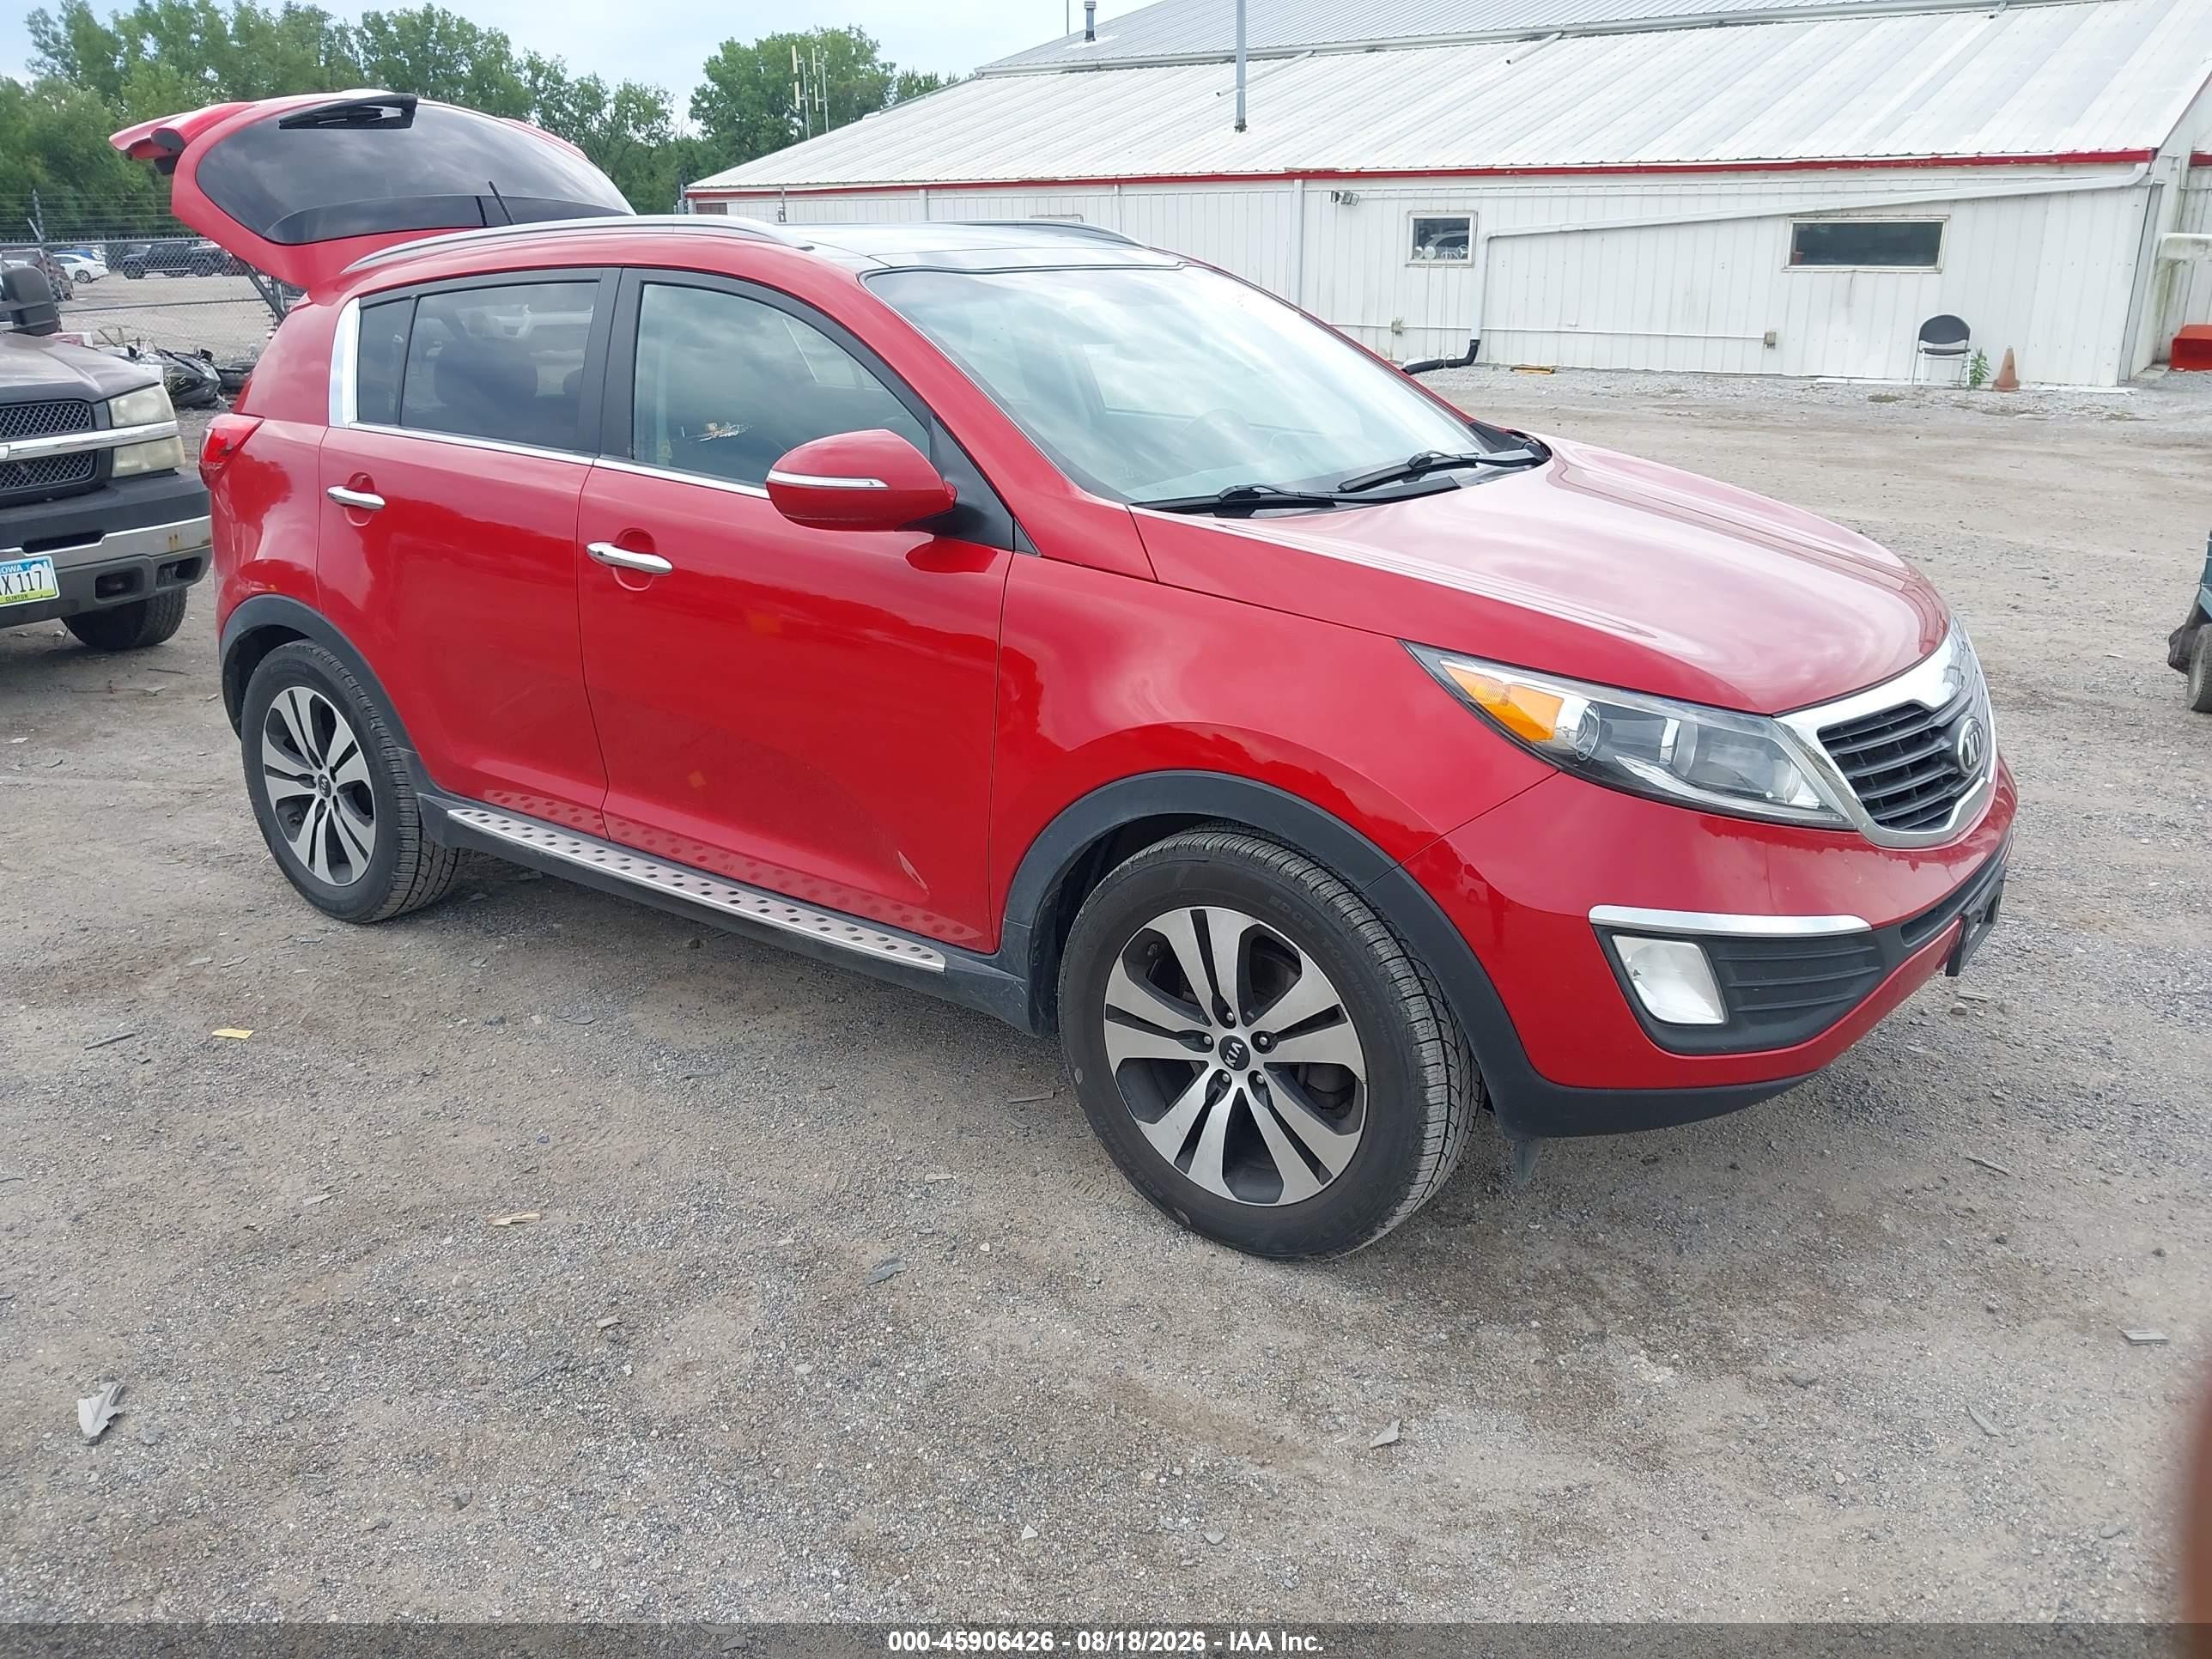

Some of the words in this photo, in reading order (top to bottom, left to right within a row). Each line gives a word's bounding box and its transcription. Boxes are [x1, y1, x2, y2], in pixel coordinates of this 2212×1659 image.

[0, 564, 23, 574] OWA
[17, 571, 42, 592] 117
[1224, 1042, 1243, 1067] KIA
